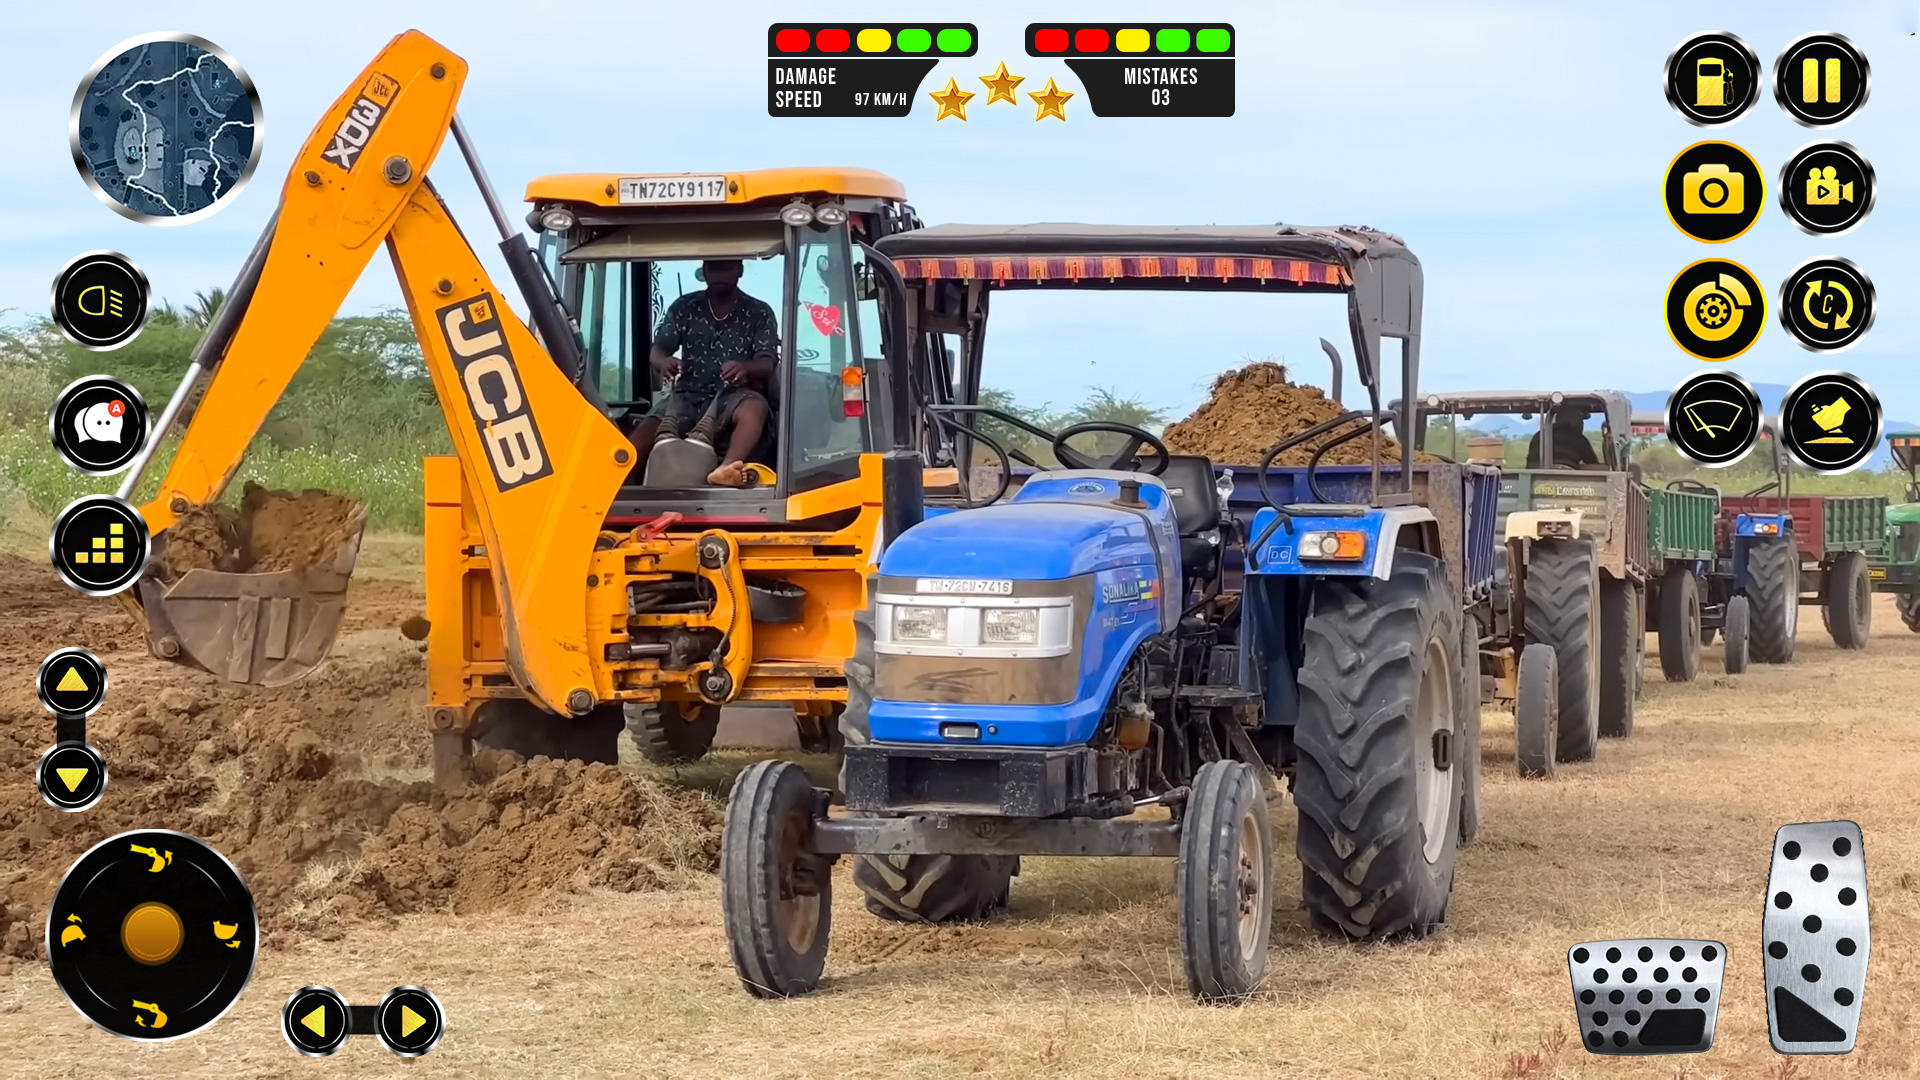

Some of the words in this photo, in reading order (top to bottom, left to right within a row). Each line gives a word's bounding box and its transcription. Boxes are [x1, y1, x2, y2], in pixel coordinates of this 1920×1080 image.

[324, 98, 381, 168] 3DX
[630, 181, 724, 199] TN72CY9117
[444, 306, 545, 487] JCB
